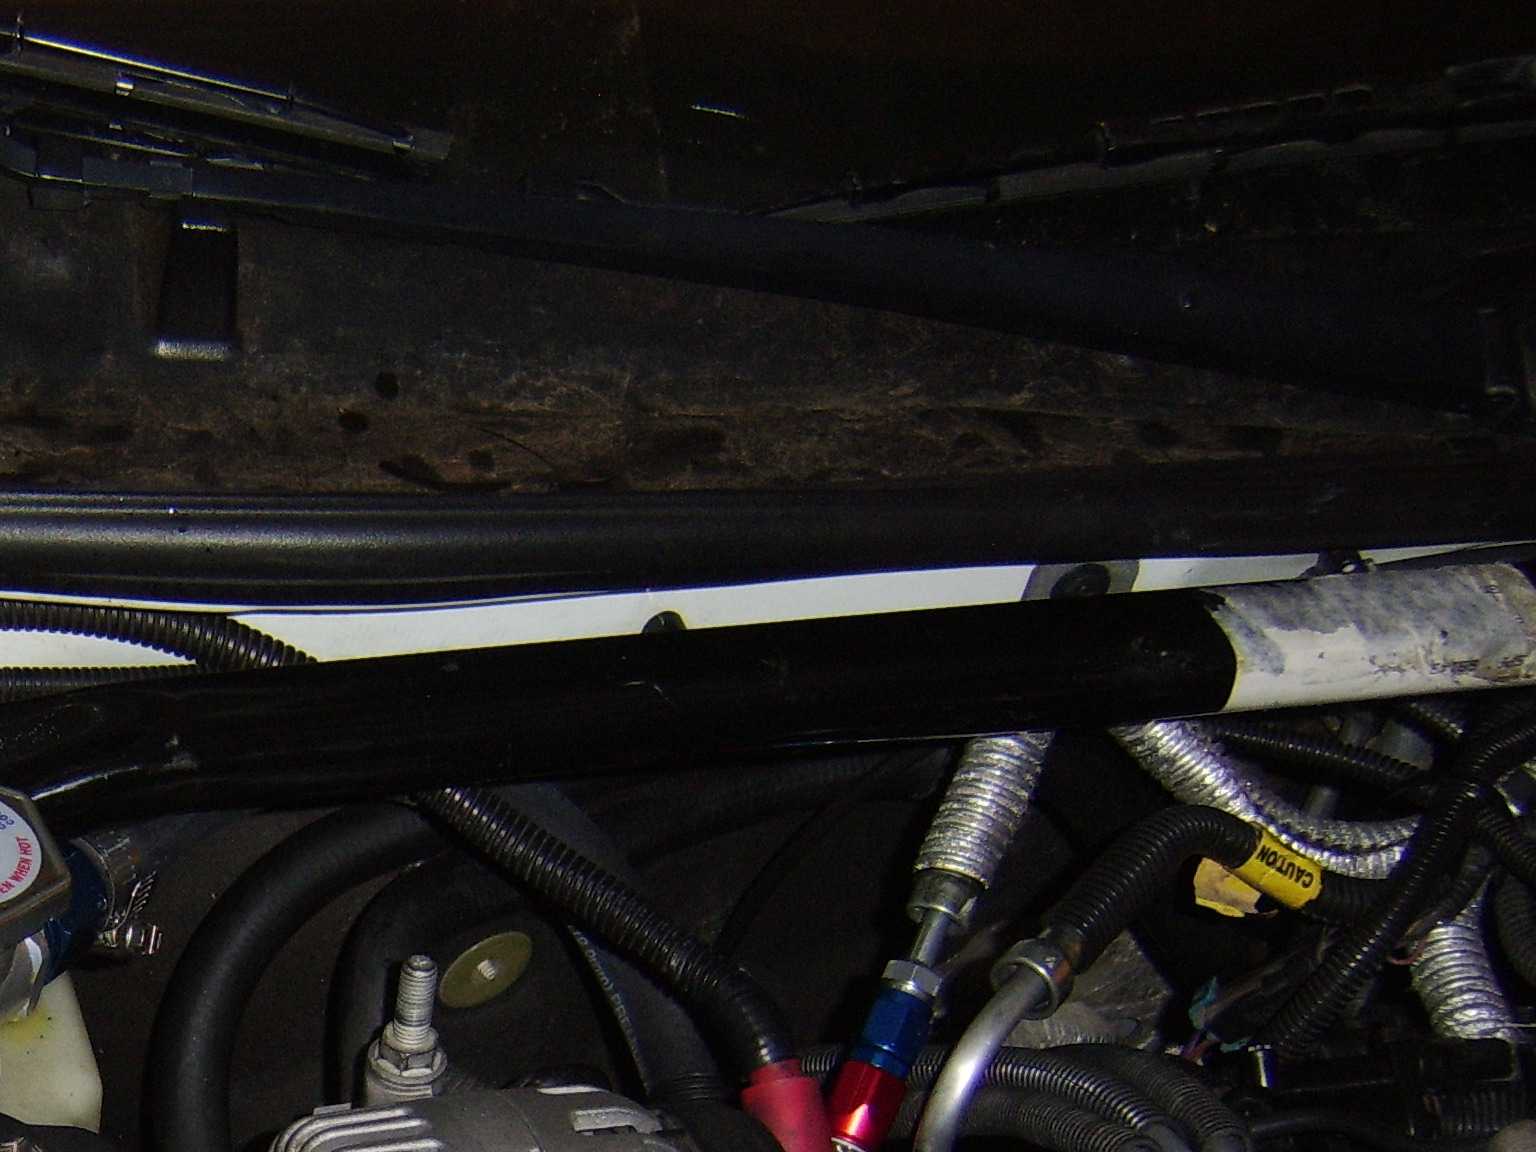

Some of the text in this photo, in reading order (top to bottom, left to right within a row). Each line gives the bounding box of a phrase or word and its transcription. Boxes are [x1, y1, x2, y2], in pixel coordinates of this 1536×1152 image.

[15, 835, 33, 858] HOT
[10, 857, 34, 884] WHEN
[1255, 844, 1315, 889] CAUTION
